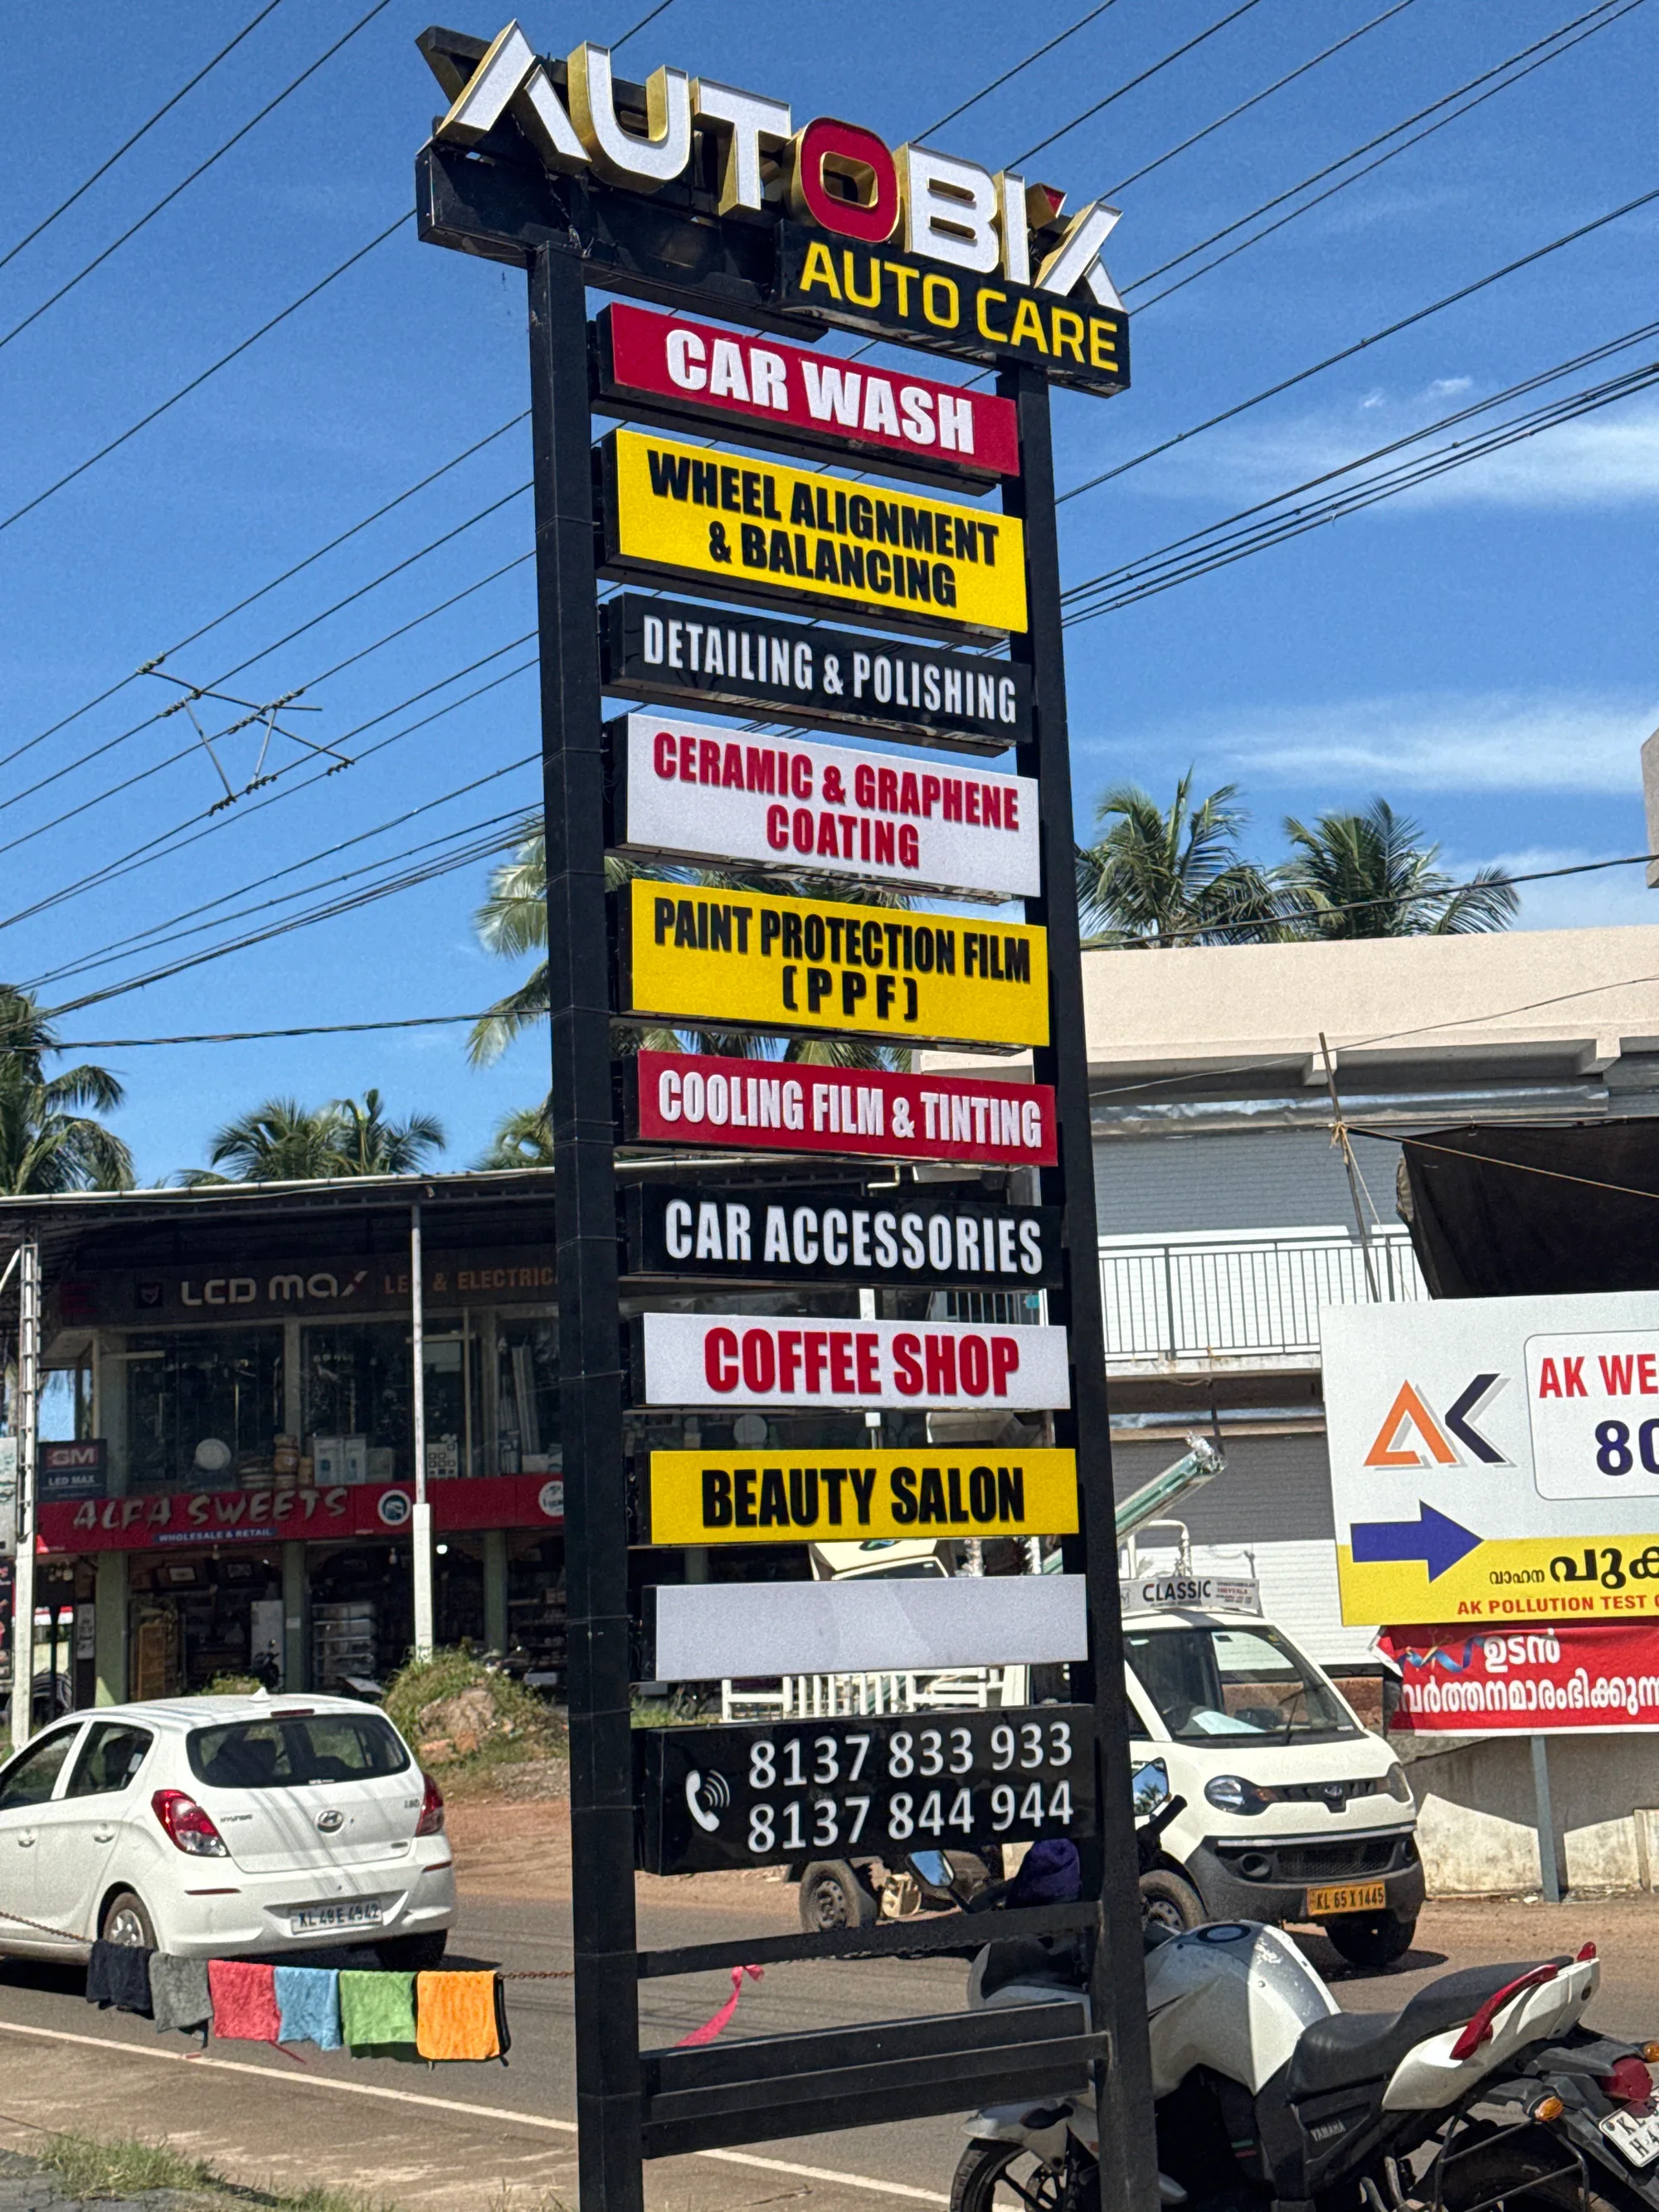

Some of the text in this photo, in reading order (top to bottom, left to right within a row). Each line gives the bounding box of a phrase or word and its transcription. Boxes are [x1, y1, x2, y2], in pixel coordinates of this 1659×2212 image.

[799, 241, 1120, 373] AUTO CARE
[664, 329, 975, 455] CAR WASH
[647, 450, 1000, 566] WHEEL ALIGNMENT
[708, 520, 956, 609] & BALANCING
[643, 614, 1017, 725] DETAILING & POLISHING
[653, 732, 1020, 832] CERAMIC & GRAPHENE
[766, 805, 920, 869] COATING
[654, 897, 1031, 984] PAINT PROTECTION FILM
[659, 1069, 1043, 1149] COOLING FILM & TINTING
[664, 1198, 1044, 1276] CAR ACCESSORIES
[384, 1266, 558, 1295] LE & ELECTRIC
[703, 1327, 1020, 1397] COFFEE SHOP
[1539, 1356, 1589, 1398] AK
[72, 1486, 348, 1530] ALFA SWEETS
[701, 1466, 1025, 1529] BEAUTY SALON
[158, 1528, 272, 1543] WHOLESALE & RETAIL
[1142, 1579, 1212, 1602] CLASSIC
[1457, 1600, 1482, 1616] AK
[1488, 1597, 1593, 1615] POLLUTION
[1600, 1594, 1647, 1612] TEST
[748, 1721, 1073, 1790] 8137 833 933
[747, 1780, 1074, 1854] 8137 844 944
[1316, 1892, 1331, 1909] KL
[1334, 1890, 1347, 1908] 65
[1350, 1889, 1357, 1908] X
[1359, 1887, 1384, 1907] 1445
[1310, 2118, 1346, 2142] YAMAHA
